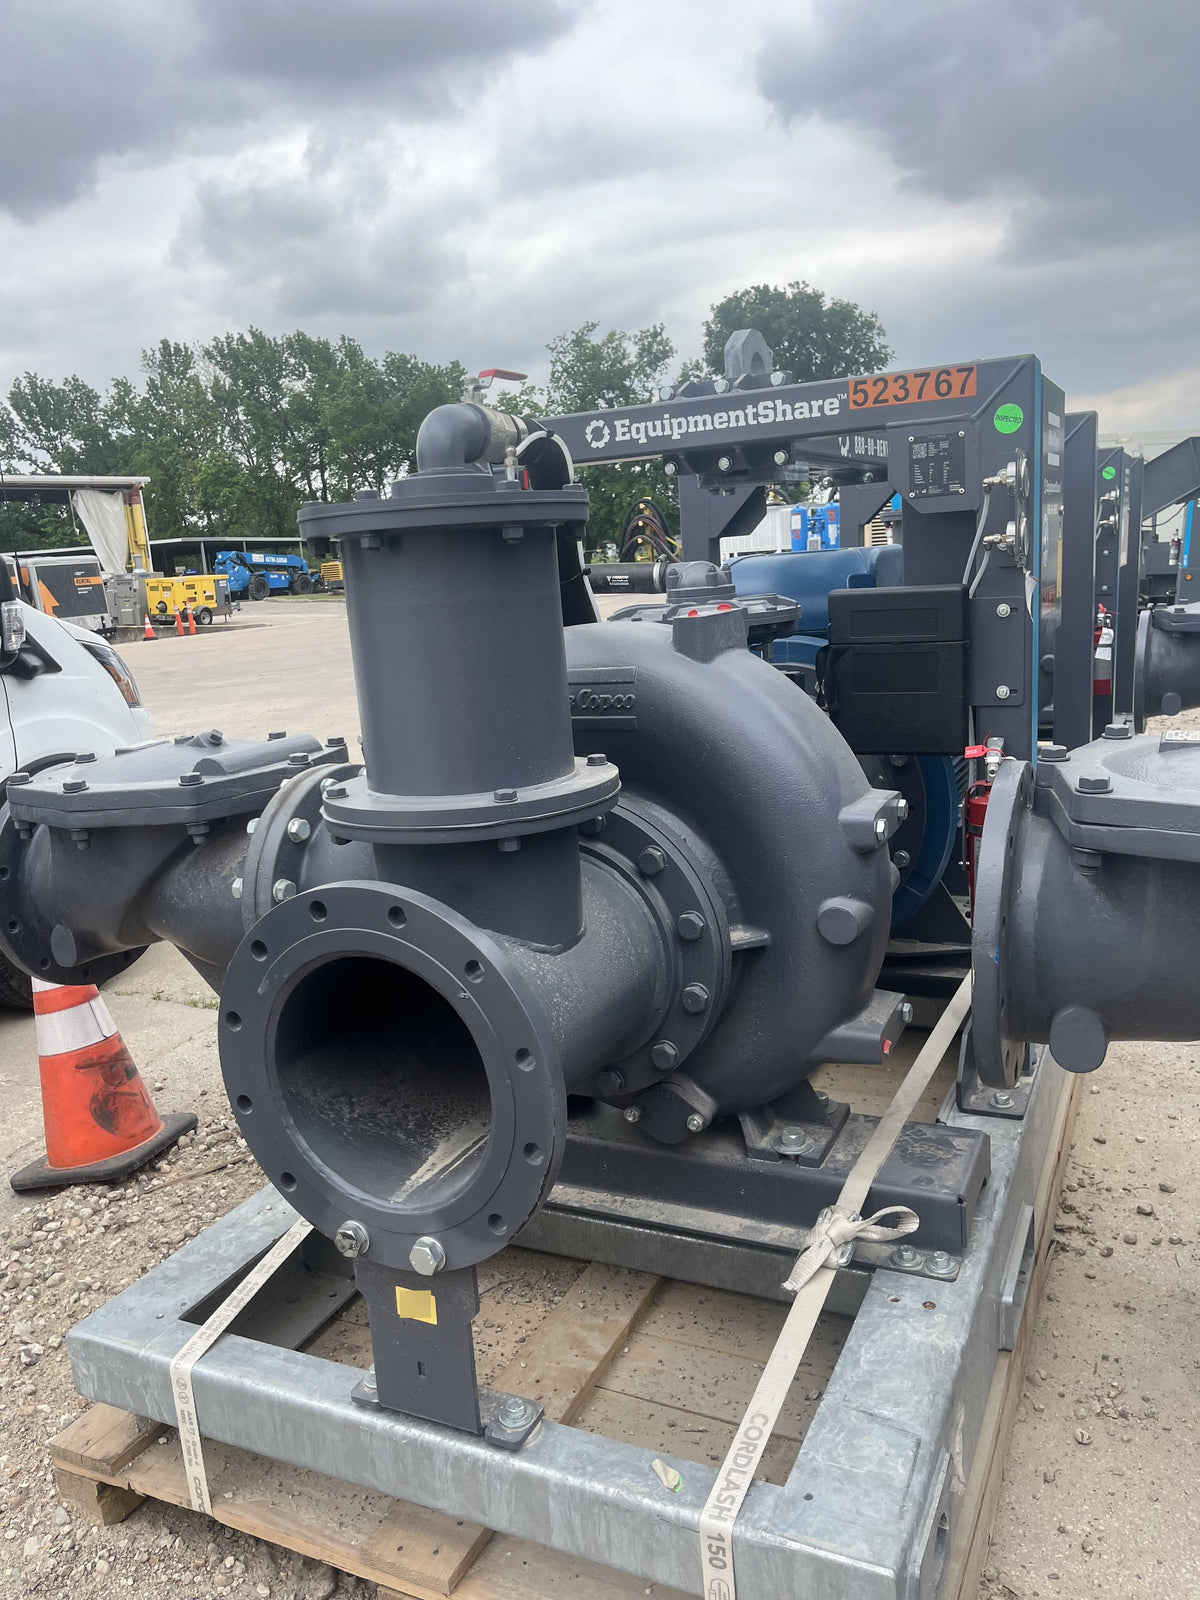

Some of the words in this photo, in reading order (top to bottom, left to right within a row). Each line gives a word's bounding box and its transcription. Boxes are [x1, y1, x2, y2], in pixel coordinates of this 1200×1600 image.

[852, 366, 975, 407] 523767
[614, 398, 840, 444] EquipmentShare
[995, 414, 1023, 424] INSPECTED
[708, 1413, 769, 1524] CORDLASH
[706, 1532, 728, 1571] 150
